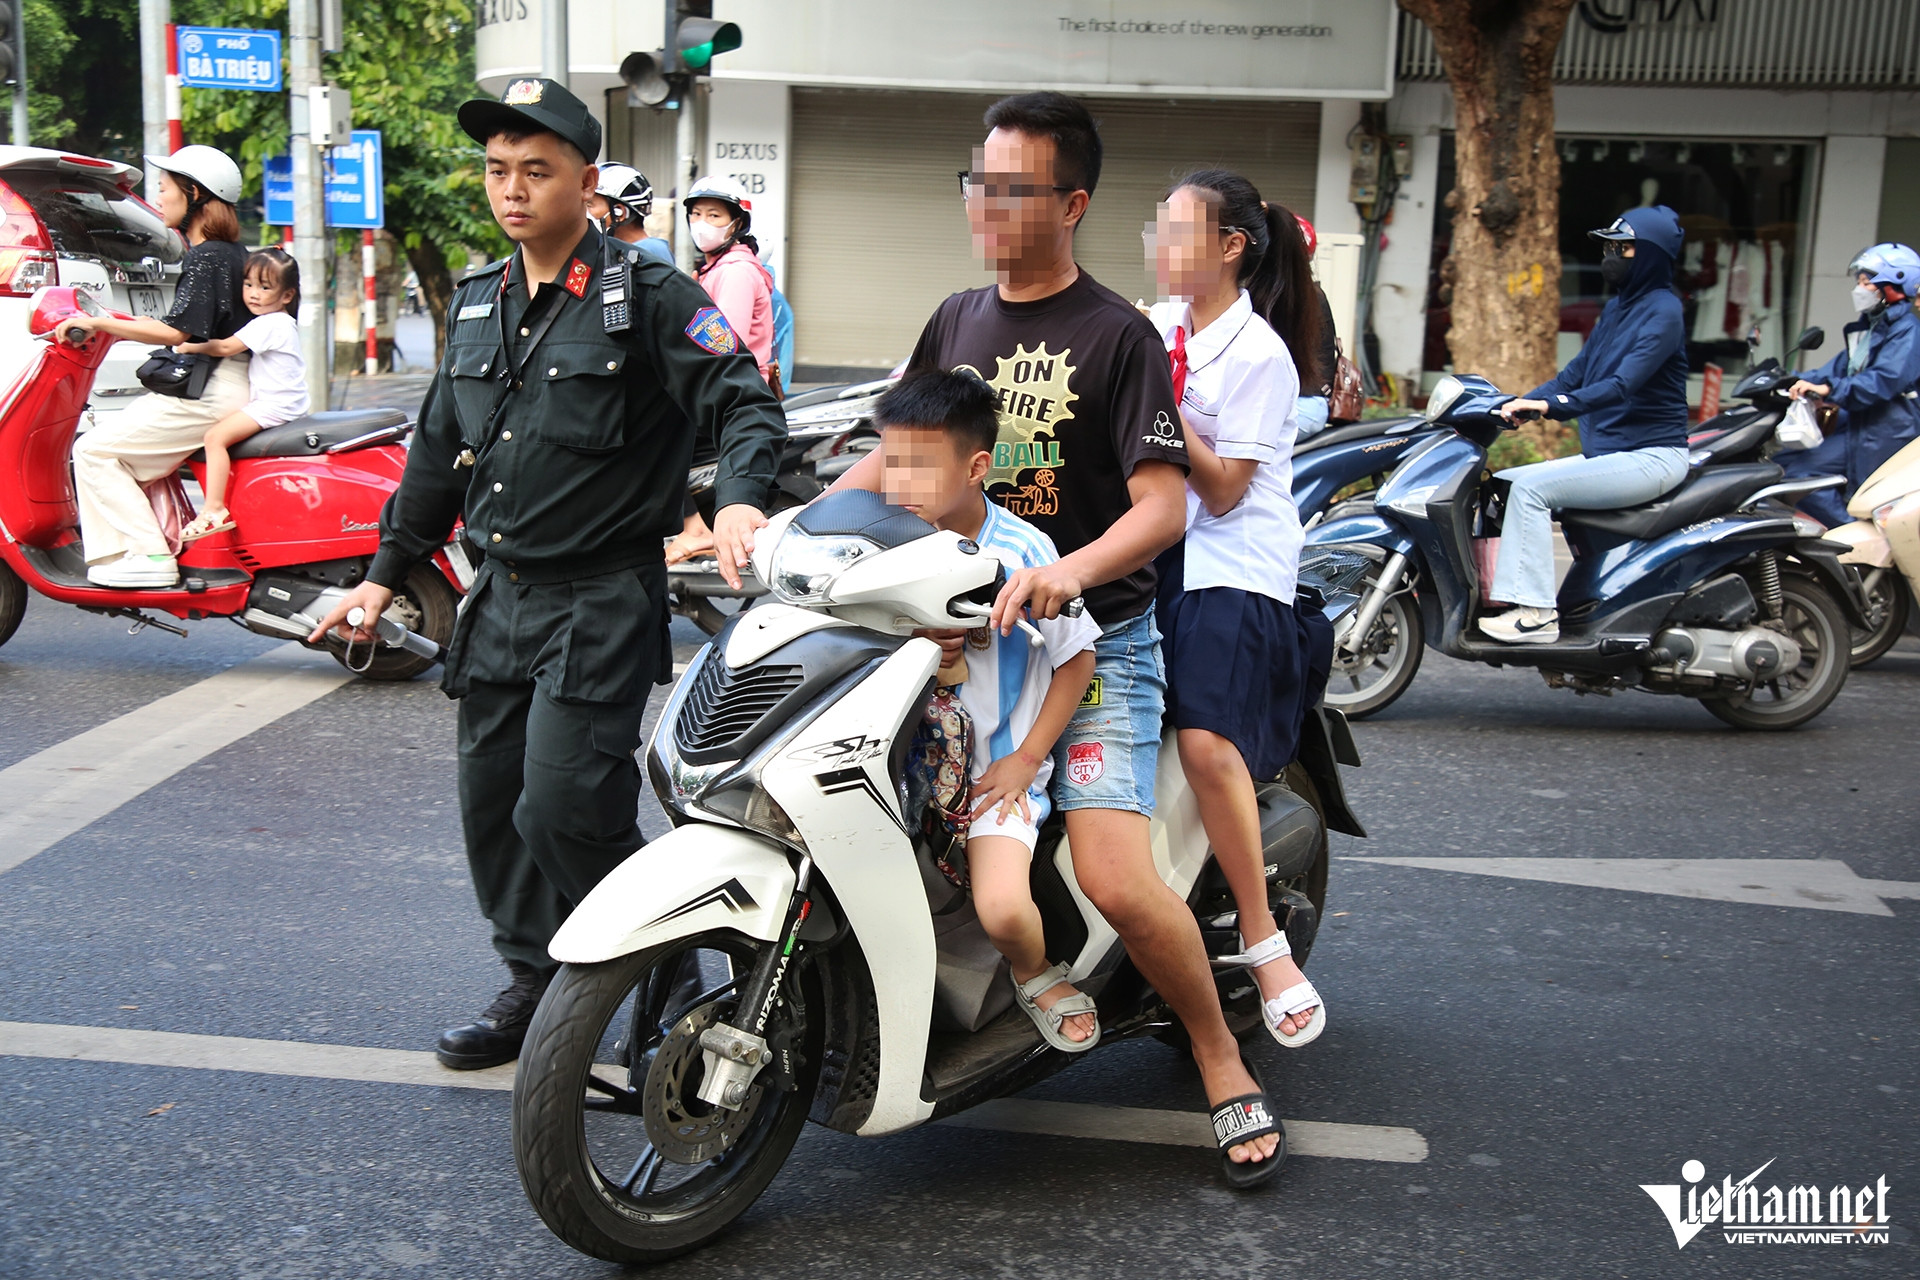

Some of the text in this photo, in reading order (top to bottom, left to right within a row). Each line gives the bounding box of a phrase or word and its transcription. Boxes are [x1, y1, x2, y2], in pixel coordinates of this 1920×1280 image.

[1058, 17, 1332, 40] The first choice of the new generation
[216, 36, 250, 50] PHỐ
[187, 53, 271, 84] BÀ TRIỆU
[716, 143, 777, 160] DEXUS
[729, 173, 765, 194] 8B
[139, 292, 159, 314] 30A
[1014, 360, 1054, 384] ON
[999, 387, 1055, 423] FIRE
[994, 441, 1064, 469] BALL
[1074, 764, 1096, 774] CITY
[756, 956, 790, 1032] RIZOMA
